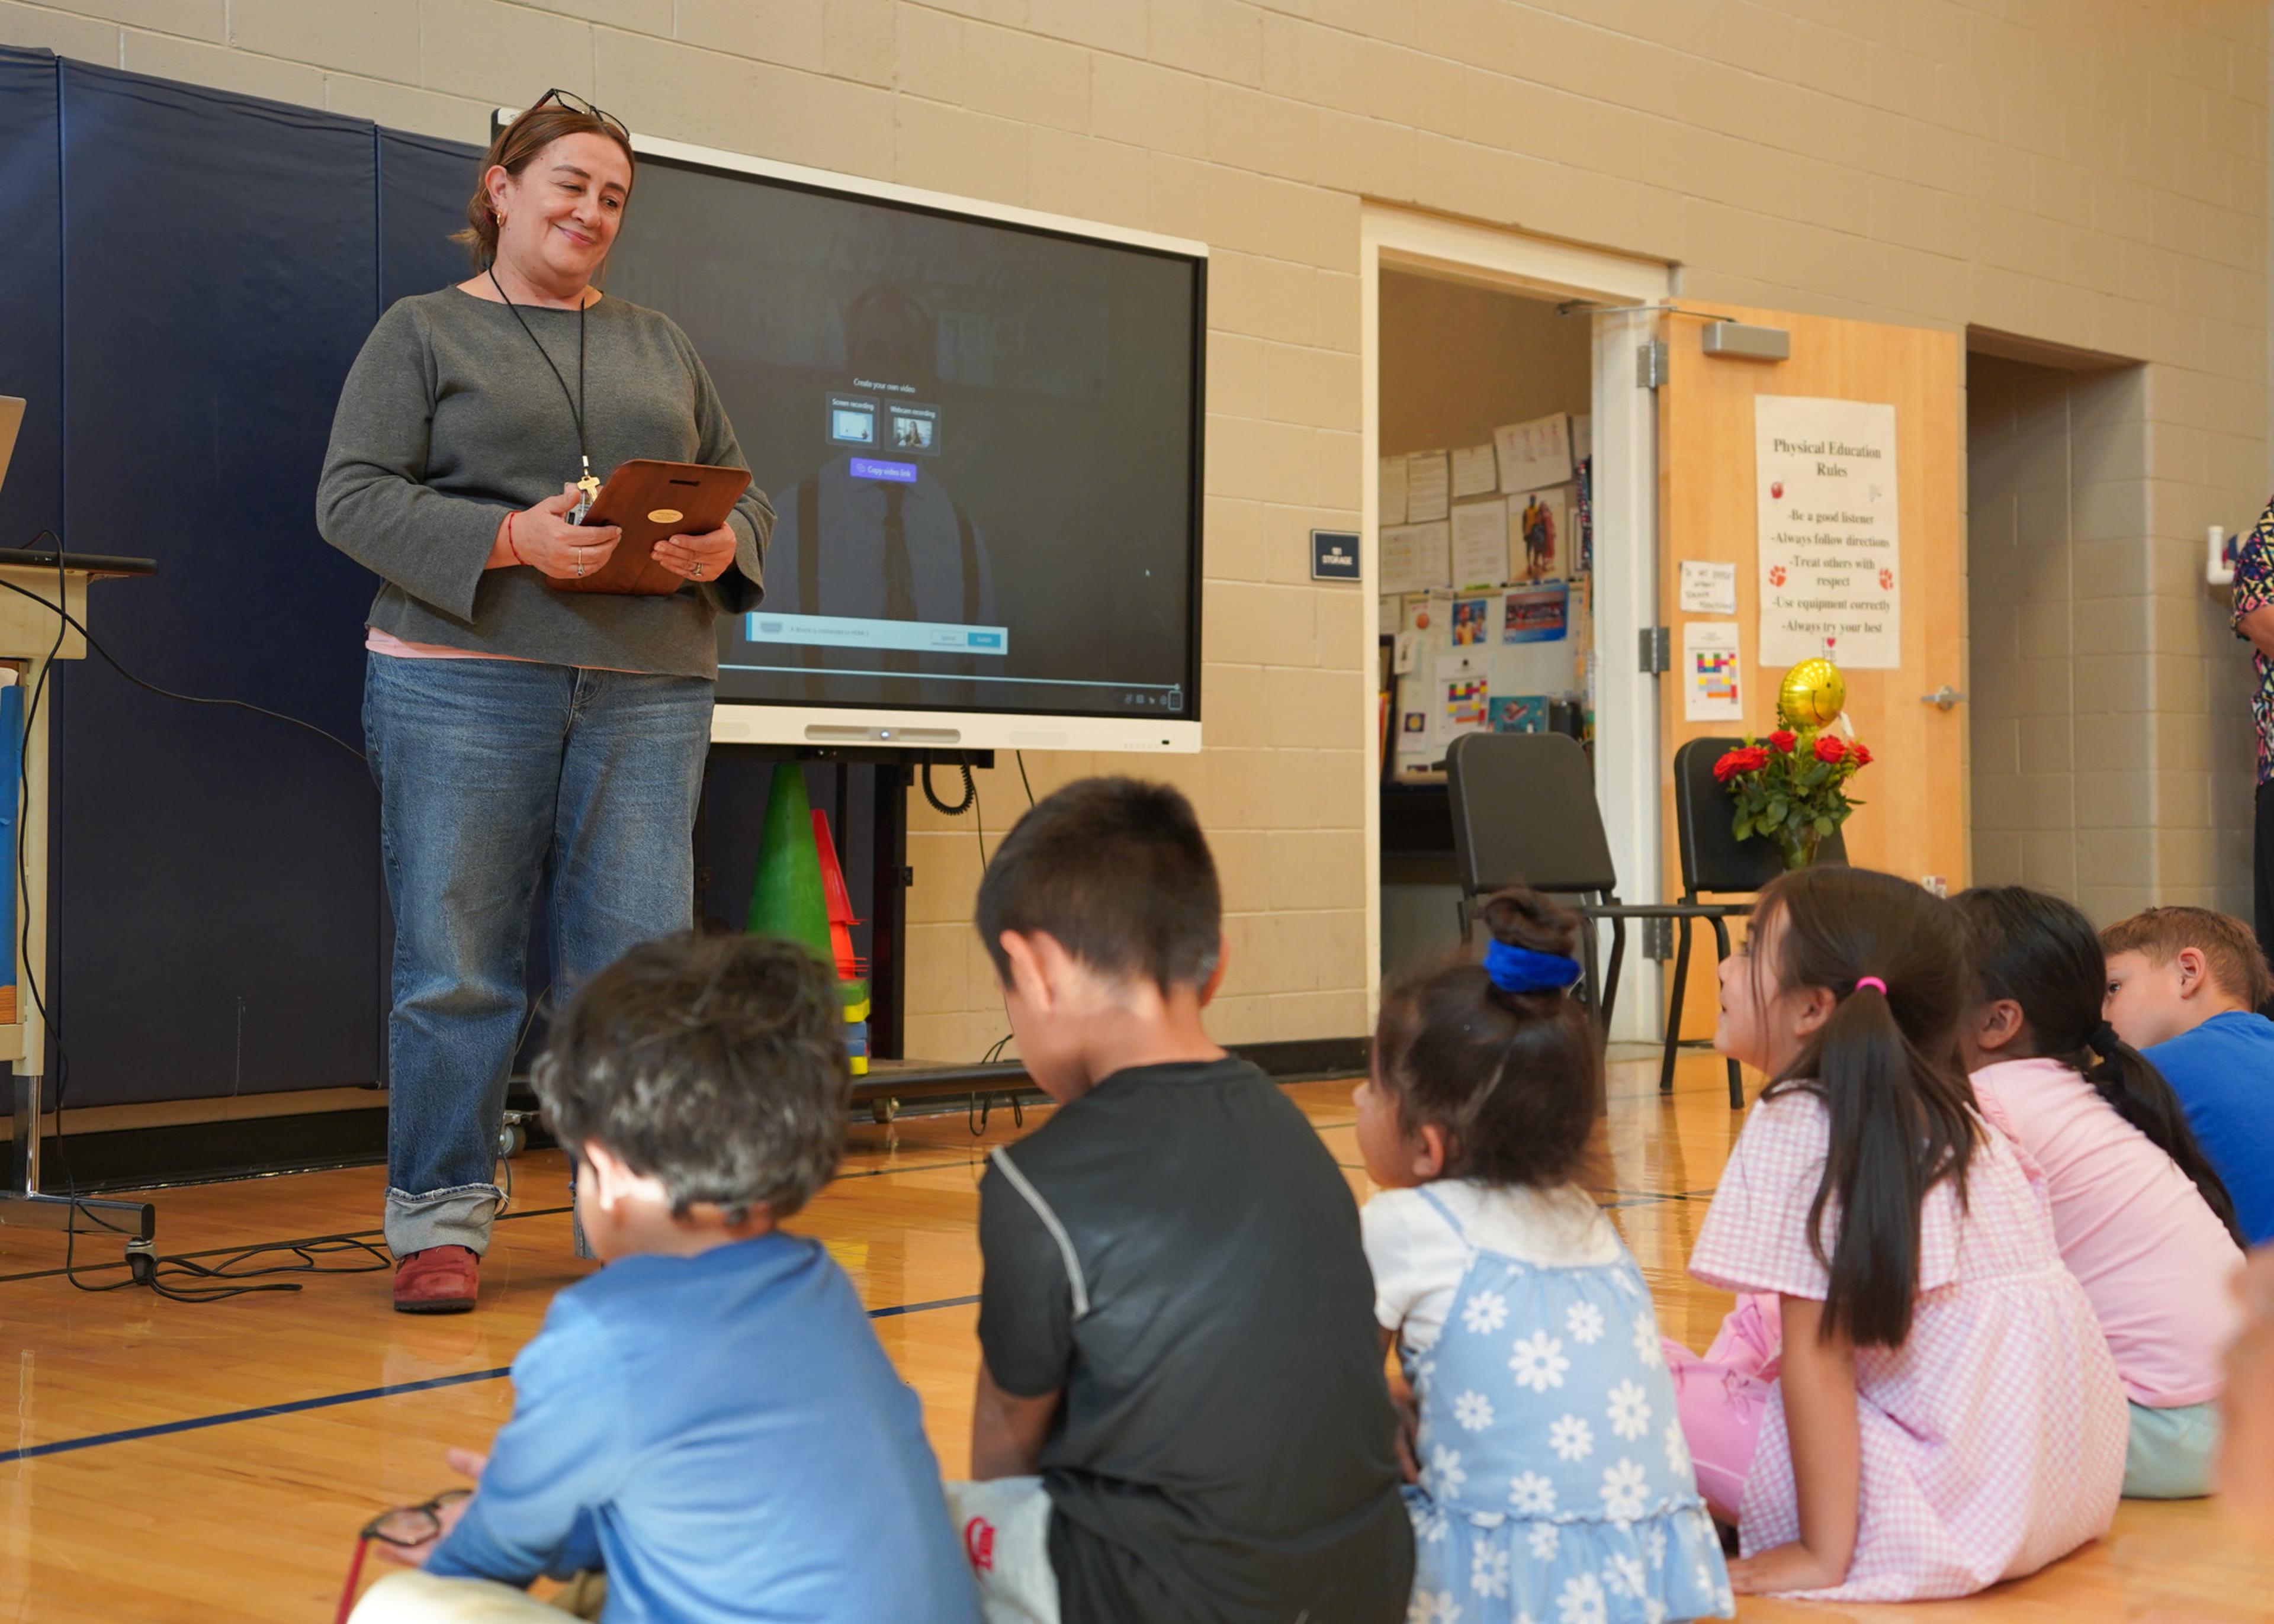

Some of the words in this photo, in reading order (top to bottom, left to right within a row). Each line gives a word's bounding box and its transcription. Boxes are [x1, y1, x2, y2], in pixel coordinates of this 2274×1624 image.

[853, 378, 872, 388] Create
[873, 382, 887, 390] your
[900, 385, 916, 393] video
[832, 398, 849, 407] Screen
[850, 400, 875, 411] recording
[1774, 438, 1825, 456] Physical
[1829, 441, 1881, 459] Education
[868, 465, 882, 476] Copy
[883, 467, 900, 477] video
[1817, 462, 1848, 477] Rules
[1816, 510, 1839, 524] good
[1842, 512, 1874, 524] listener
[1771, 532, 1812, 546] -Always
[1814, 533, 1842, 545] follow
[1846, 535, 1890, 548] directions
[1789, 555, 1820, 568] -Treat
[1823, 557, 1853, 568] others
[1856, 558, 1875, 570] with
[1817, 577, 1850, 589] respect
[1773, 596, 1794, 608] -Use
[1797, 597, 1847, 611] equipment
[1850, 599, 1890, 612] correctly
[1782, 620, 1820, 634] -Always
[1823, 622, 1836, 635] try
[1839, 623, 1861, 635] your
[1864, 622, 1882, 633] best
